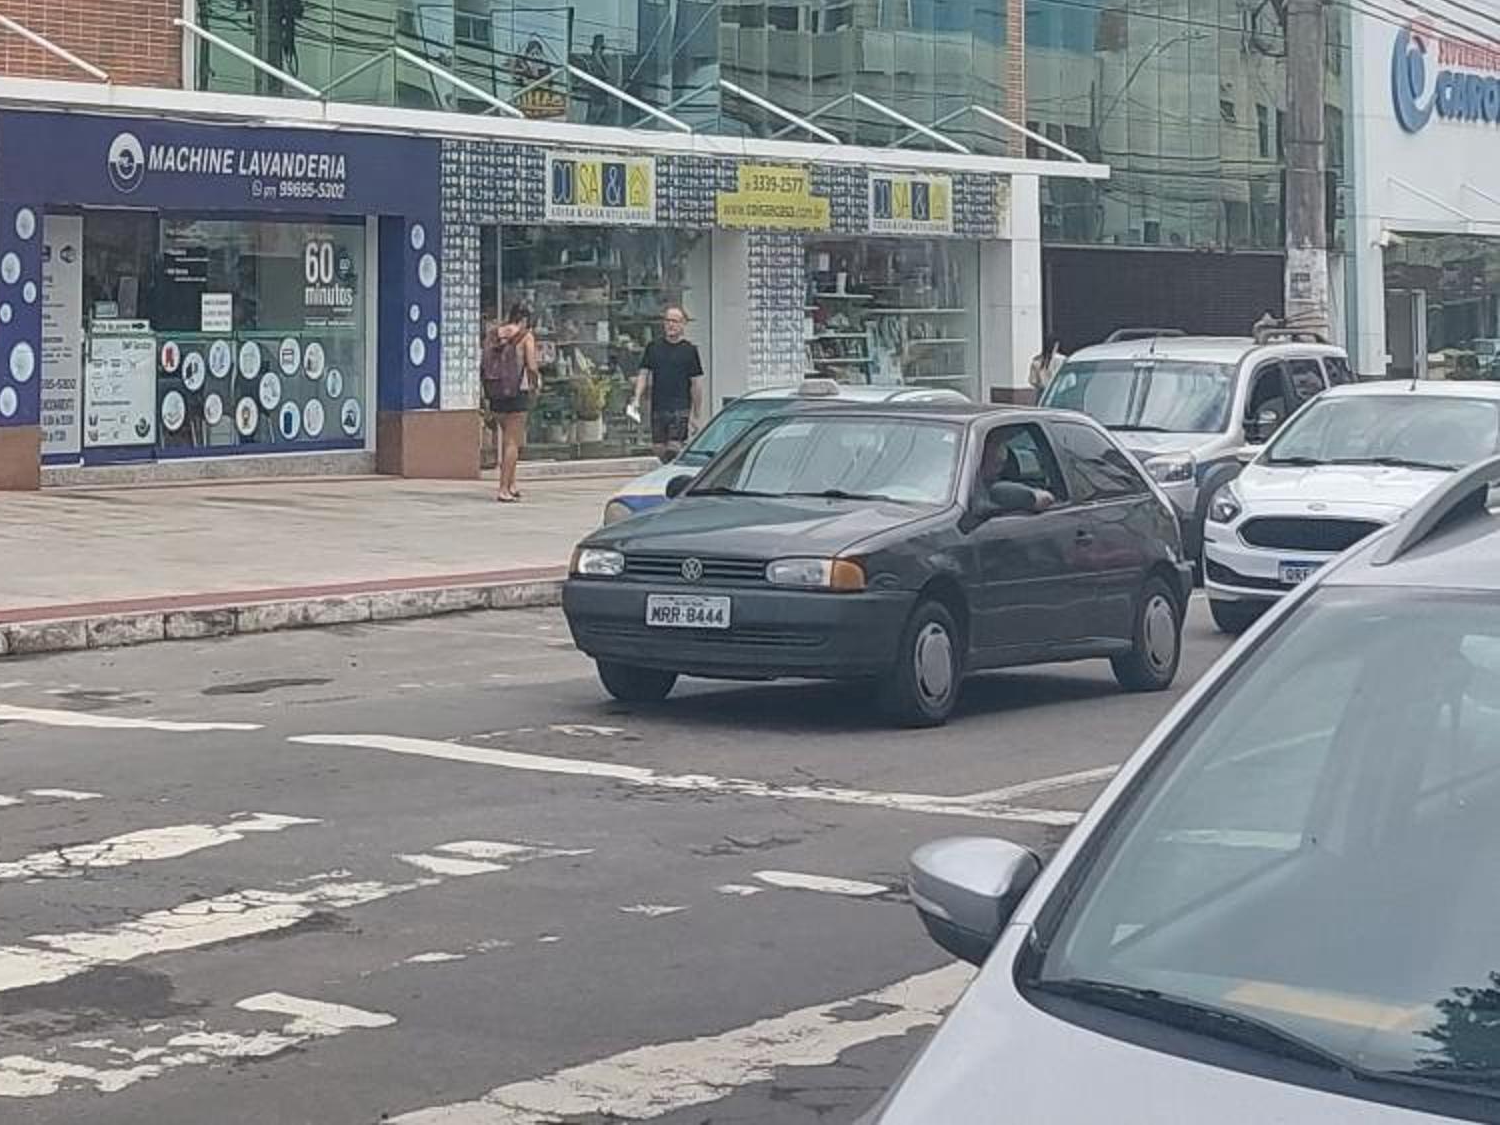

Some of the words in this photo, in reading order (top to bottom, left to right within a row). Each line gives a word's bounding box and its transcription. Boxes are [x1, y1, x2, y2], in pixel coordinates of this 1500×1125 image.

[148, 145, 235, 174] MACHINE
[238, 149, 346, 179] LAVANDERIA
[305, 242, 334, 284] 60
[305, 282, 354, 306] minutos
